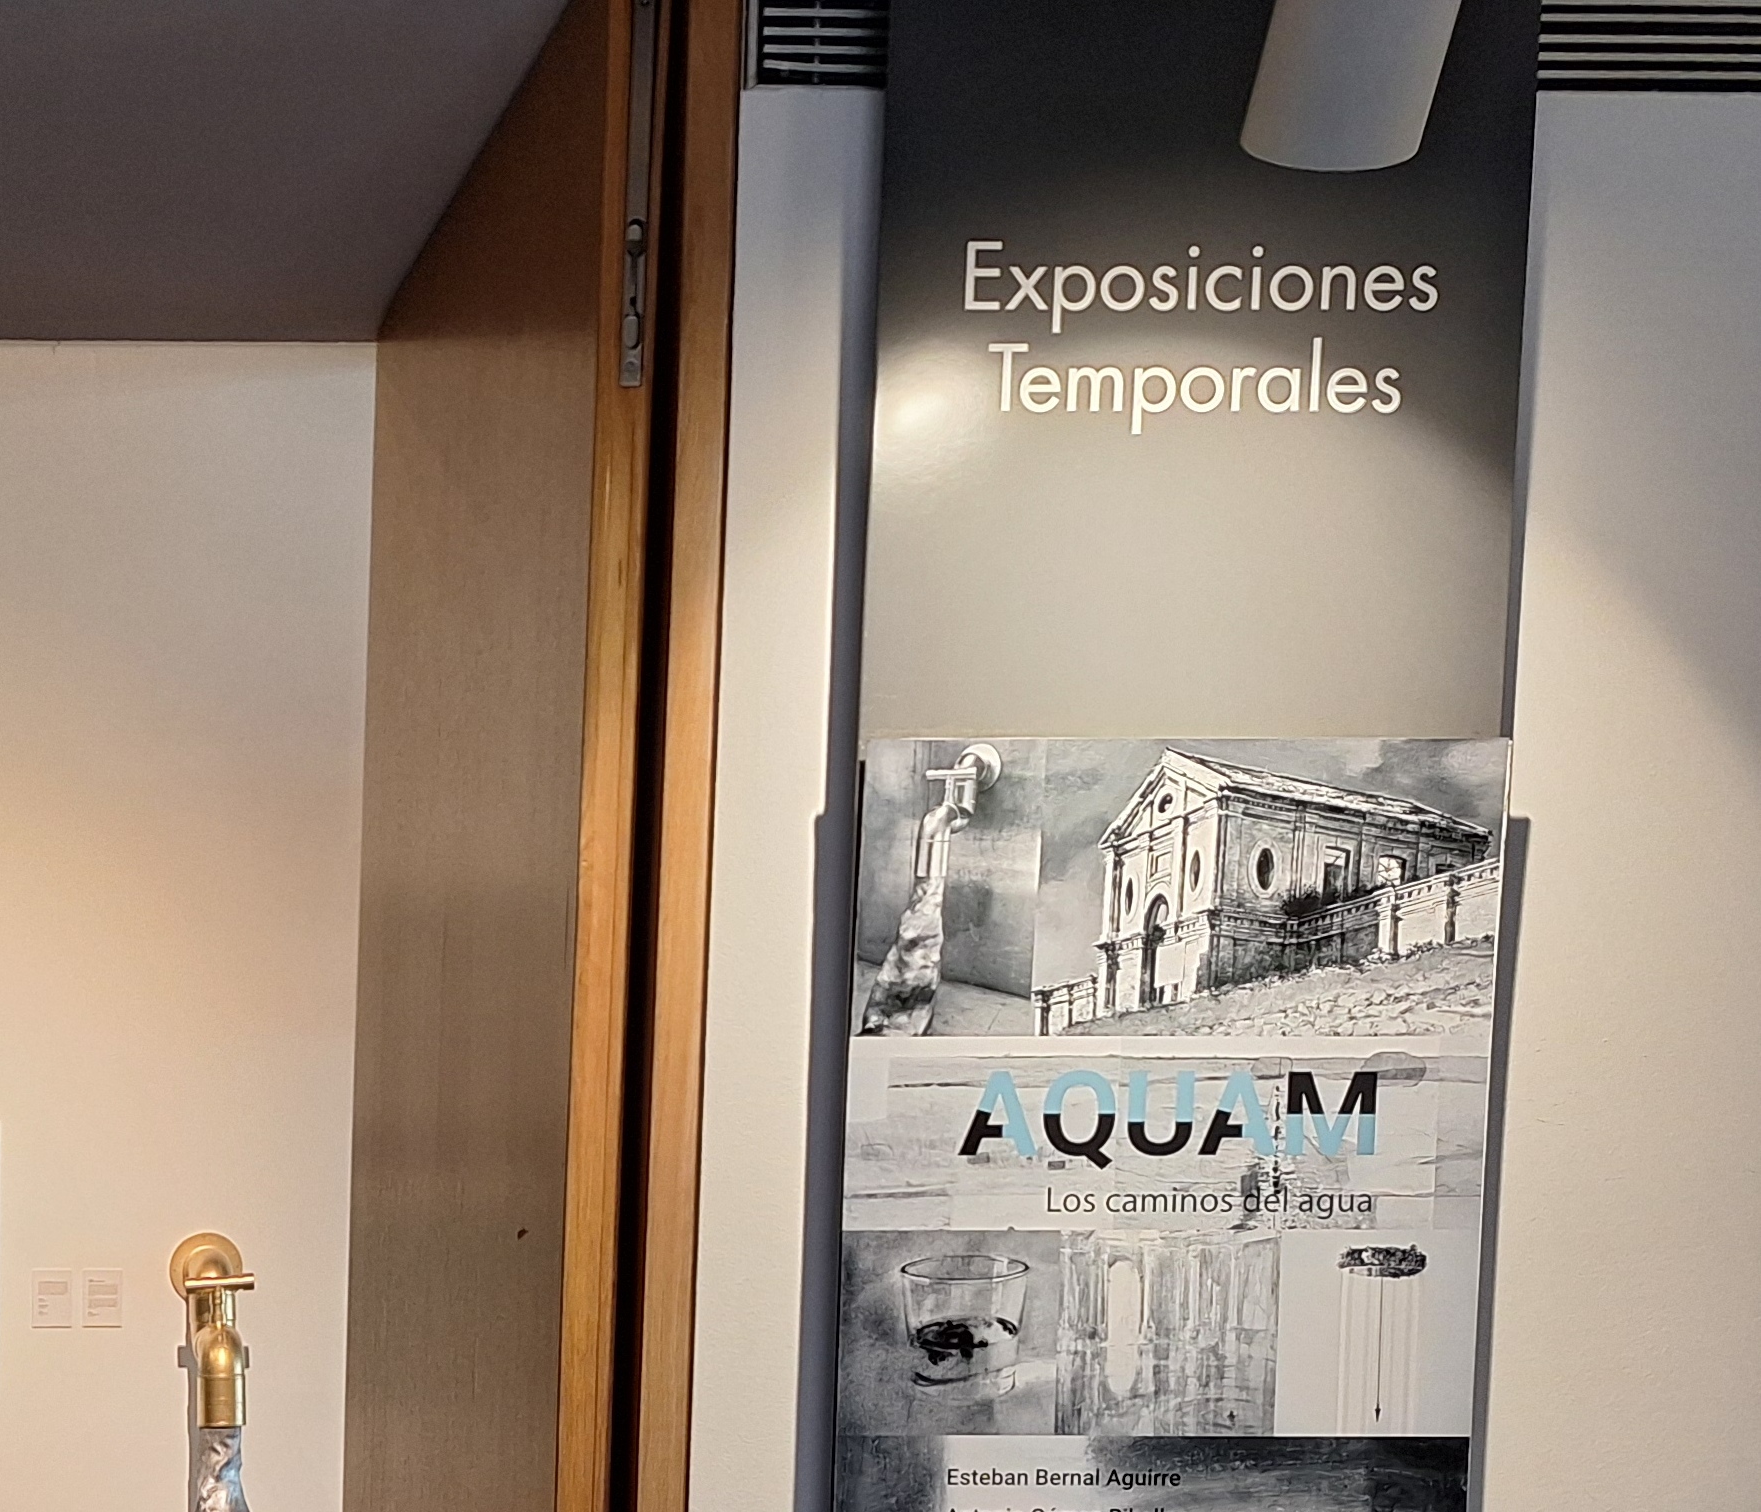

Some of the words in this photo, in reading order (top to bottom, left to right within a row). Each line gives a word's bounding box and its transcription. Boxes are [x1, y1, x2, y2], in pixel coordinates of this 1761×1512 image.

[964, 240, 1439, 334] Exposiciones
[988, 337, 1402, 435] Temporales
[957, 1070, 1379, 1169] AQUAM
[1046, 1187, 1097, 1214] Los
[1105, 1187, 1234, 1214] caminos
[1243, 1187, 1290, 1214] del
[1299, 1192, 1374, 1220] agua
[947, 1468, 1029, 1488] Esteban
[1036, 1468, 1100, 1487] Bernal
[1106, 1469, 1181, 1491] Aguirre
